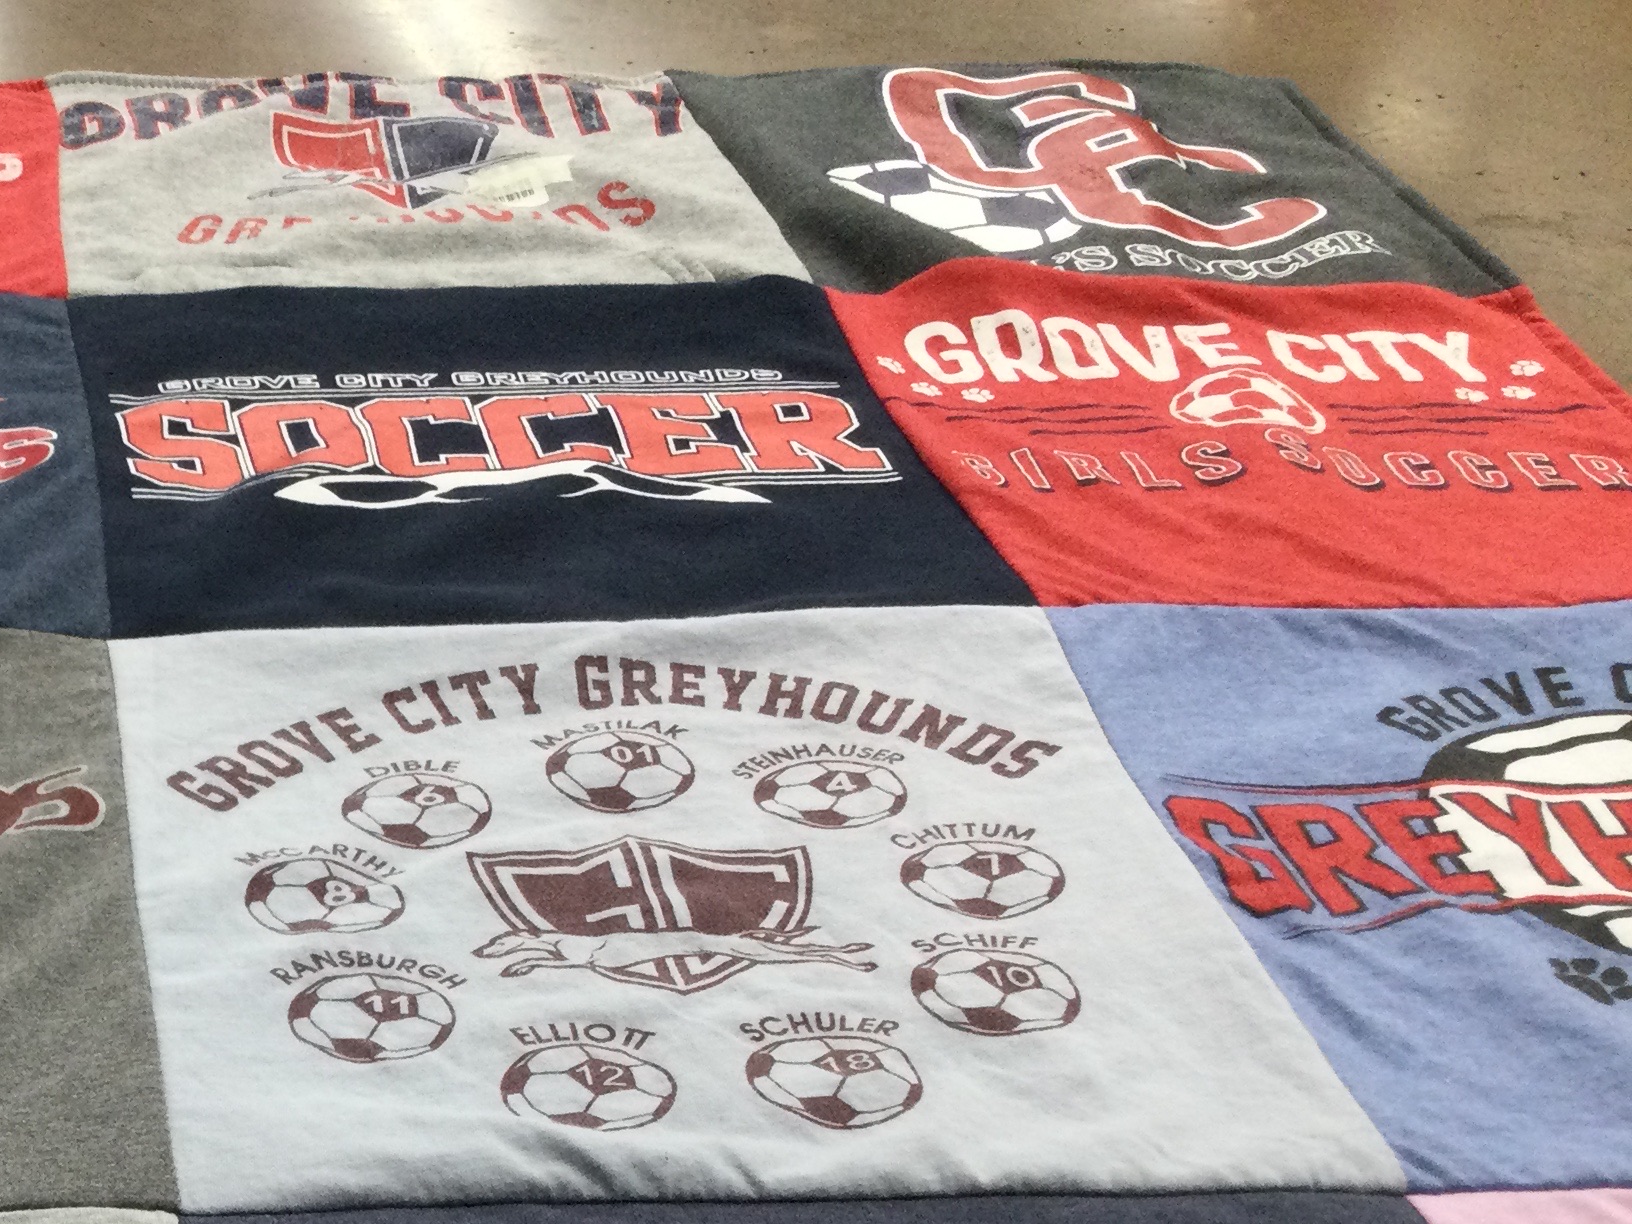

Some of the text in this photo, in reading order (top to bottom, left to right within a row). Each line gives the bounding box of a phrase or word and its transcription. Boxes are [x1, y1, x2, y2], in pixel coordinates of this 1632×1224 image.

[438, 73, 683, 138] CITY
[1125, 230, 1392, 281] SOCCER
[903, 309, 1487, 384] GROVE CITY
[158, 367, 783, 394] GROVE CITY GREYHOUNDS
[114, 389, 891, 490] SOCCER
[952, 427, 1632, 494] GIRLS SOCCER
[1376, 666, 1586, 742] GROVE
[166, 655, 1064, 812] GROVE CITY GREYHOUNDS
[530, 719, 689, 751] MASTILAK
[609, 744, 655, 764] 01
[731, 743, 905, 780] STEINHAUSER
[363, 760, 461, 779] DIBLE
[825, 774, 857, 794] 4
[416, 786, 445, 805] 6
[890, 822, 1036, 851] CHITTUM
[323, 879, 356, 906] 8
[910, 932, 1040, 955] SCHIFF
[269, 949, 469, 990] RANSBURGH
[985, 966, 1037, 987] 10
[364, 995, 410, 1015] 11
[509, 1022, 656, 1051] ELLIOTT
[739, 1012, 900, 1043] SCHULER
[574, 1065, 628, 1088] 12
[820, 1052, 875, 1072] 18
